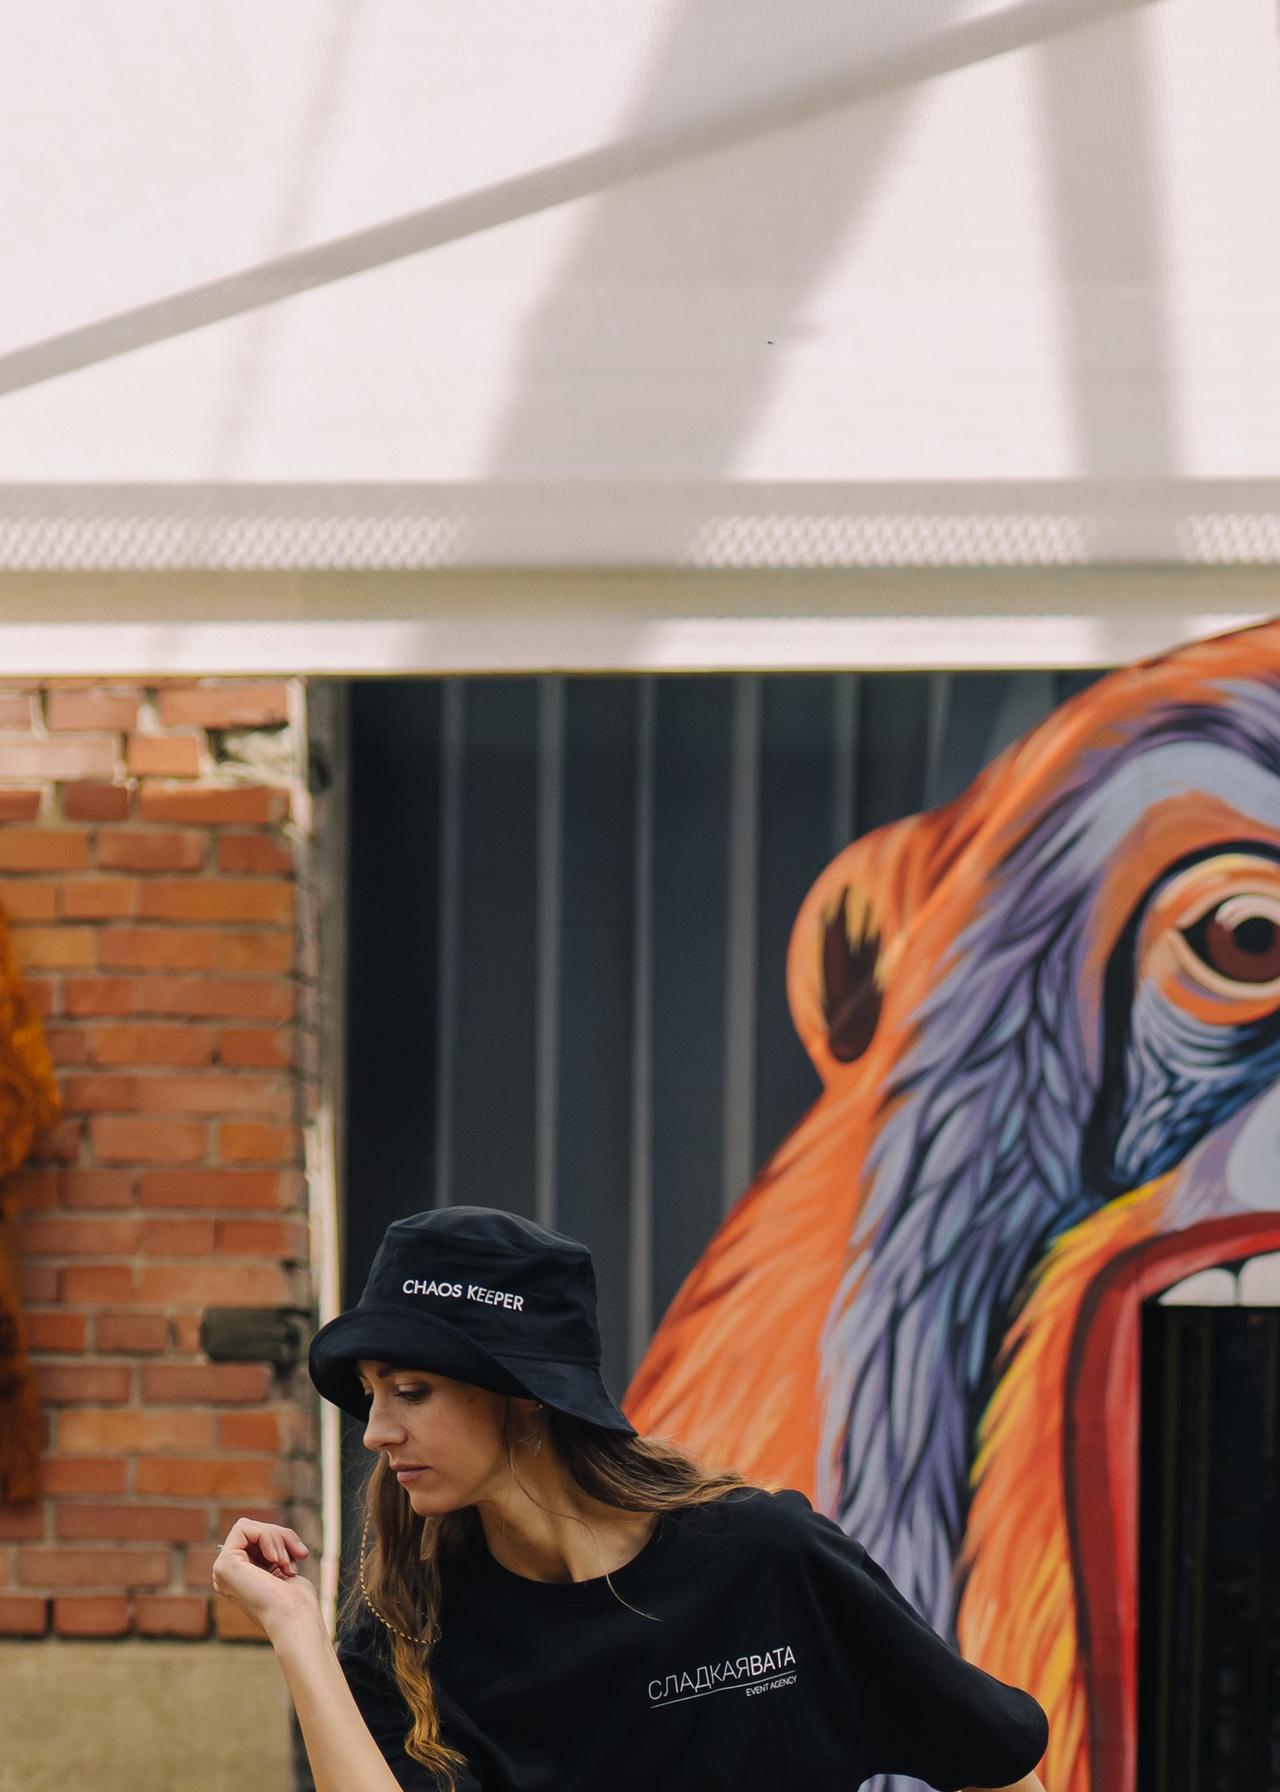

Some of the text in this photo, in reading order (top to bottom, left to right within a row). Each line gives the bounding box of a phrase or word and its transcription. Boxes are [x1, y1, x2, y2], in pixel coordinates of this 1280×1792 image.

[402, 1279, 525, 1312] CHAOS KEEPER
[648, 1645, 796, 1700] СЛАДКАЯВАТА
[745, 1674, 798, 1697] EVENT AGENCY
